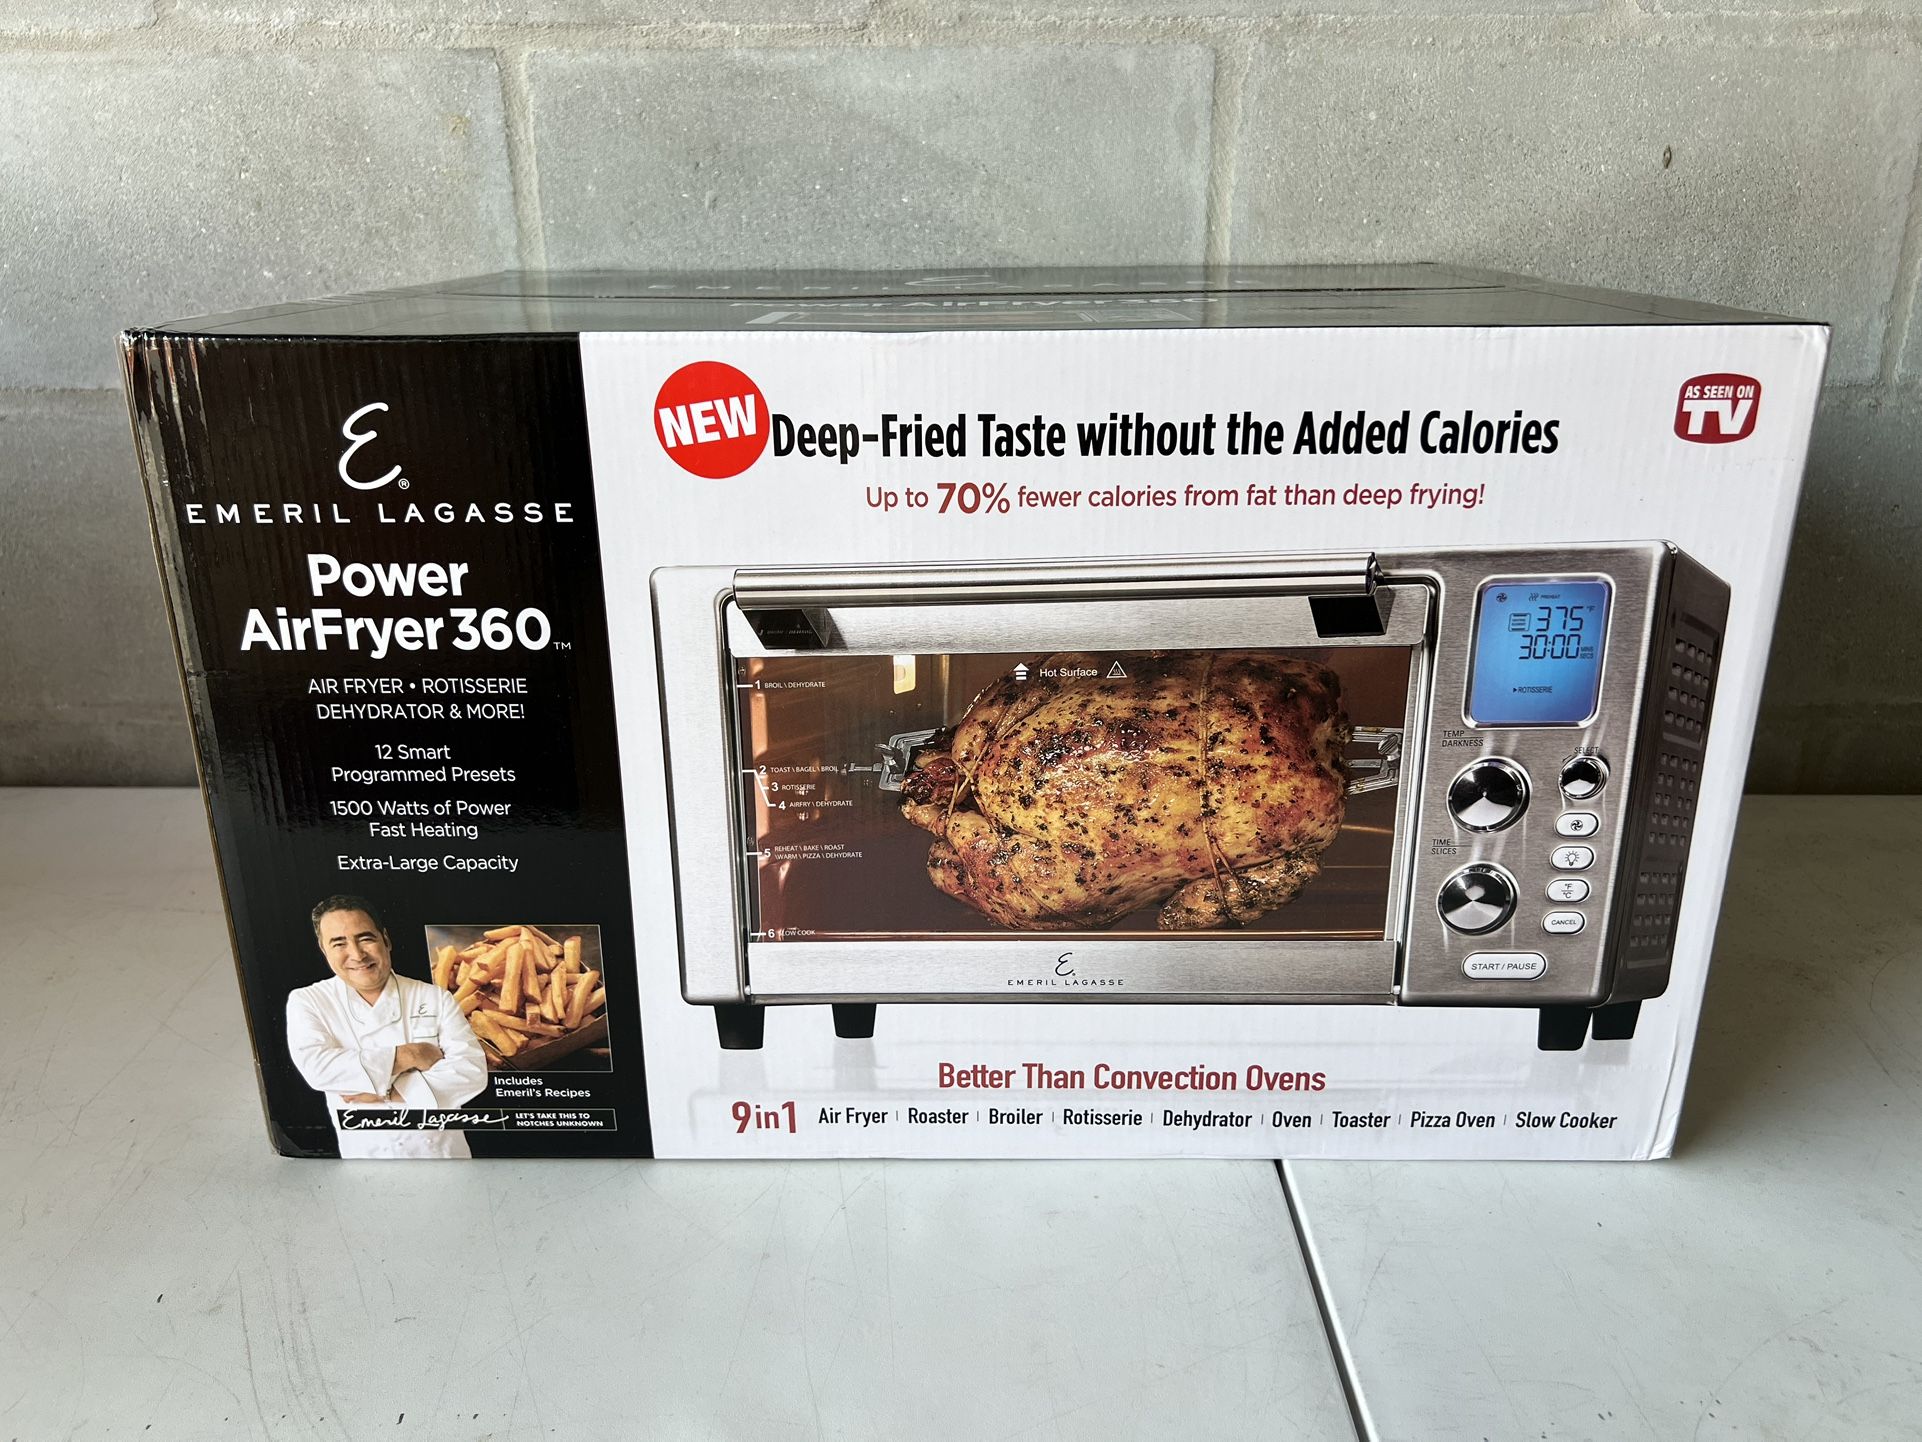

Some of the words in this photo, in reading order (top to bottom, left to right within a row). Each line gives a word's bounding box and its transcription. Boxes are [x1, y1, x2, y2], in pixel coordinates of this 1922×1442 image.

[1685, 386, 1700, 398] AS
[1703, 386, 1733, 398] SEEN
[1736, 386, 1755, 398] ON
[658, 393, 758, 448] NEW
[1682, 400, 1753, 434] TV
[772, 414, 967, 465] Deep-Fried
[977, 414, 1065, 458] Taste
[1077, 413, 1214, 457] without
[1227, 412, 1284, 455] the
[1293, 411, 1408, 455] Added
[1419, 410, 1560, 454] Calories
[866, 487, 898, 512] Up
[904, 488, 929, 508] to
[937, 483, 1010, 514] 70%
[1018, 486, 1081, 507] fewer
[1088, 485, 1177, 507] calories
[1184, 484, 1239, 507] from
[1245, 484, 1276, 506] fat
[1284, 484, 1336, 506] than
[1343, 484, 1402, 510] deep
[1409, 483, 1485, 510] frying!
[187, 503, 350, 524] EMERIL
[379, 502, 574, 523] LAGASSE
[306, 553, 468, 597] Power
[1536, 606, 1584, 631] 375
[1519, 634, 1581, 659] 30:00
[1040, 669, 1057, 677] Hot
[1060, 668, 1098, 677] Surface
[308, 679, 339, 694] AIR
[343, 679, 403, 694] FRYER
[422, 678, 528, 694] ROTISSERIE
[755, 680, 761, 689] 1
[317, 704, 442, 720] DEHYDRATOR
[449, 704, 462, 719] &
[467, 703, 525, 720] MORE!
[1442, 739, 1484, 747] DARKNESS
[375, 744, 393, 759] 12
[398, 744, 451, 760] Smart
[331, 767, 447, 784] Programmed
[452, 767, 516, 782] Presets
[759, 766, 766, 775] 2
[772, 782, 778, 791] 3
[330, 800, 373, 816] 1500
[377, 801, 428, 816] Watts
[434, 800, 452, 816] of
[456, 801, 511, 816] Power
[779, 801, 786, 810] 4
[370, 822, 406, 837] Fast
[411, 822, 478, 839] Heating
[764, 849, 771, 858] 5
[1431, 847, 1457, 855] SLICES
[338, 855, 438, 873] Extra-Large
[444, 855, 519, 873] Capacity
[768, 929, 775, 938] 6
[1471, 963, 1500, 971] START
[494, 1076, 543, 1086] Includes
[938, 1063, 1016, 1089] Better
[1022, 1063, 1085, 1089] Than
[1094, 1065, 1237, 1091] Convection
[1246, 1065, 1326, 1091] Ovens
[496, 1088, 542, 1097] Emeril's
[545, 1088, 591, 1098] Recipes
[818, 1108, 841, 1124] Air
[845, 1108, 888, 1128] Fryer
[908, 1108, 969, 1125] Roaster
[989, 1108, 1043, 1125] Broiler
[1063, 1109, 1143, 1126] Rotisserie
[1163, 1110, 1252, 1131] Dehydrator
[1272, 1111, 1311, 1128] Oven
[1333, 1111, 1390, 1128] Toaster
[1411, 1112, 1451, 1128] Pizza
[1456, 1112, 1495, 1128] Oven
[1515, 1112, 1556, 1129] Slow
[1559, 1112, 1617, 1129] Cooker
